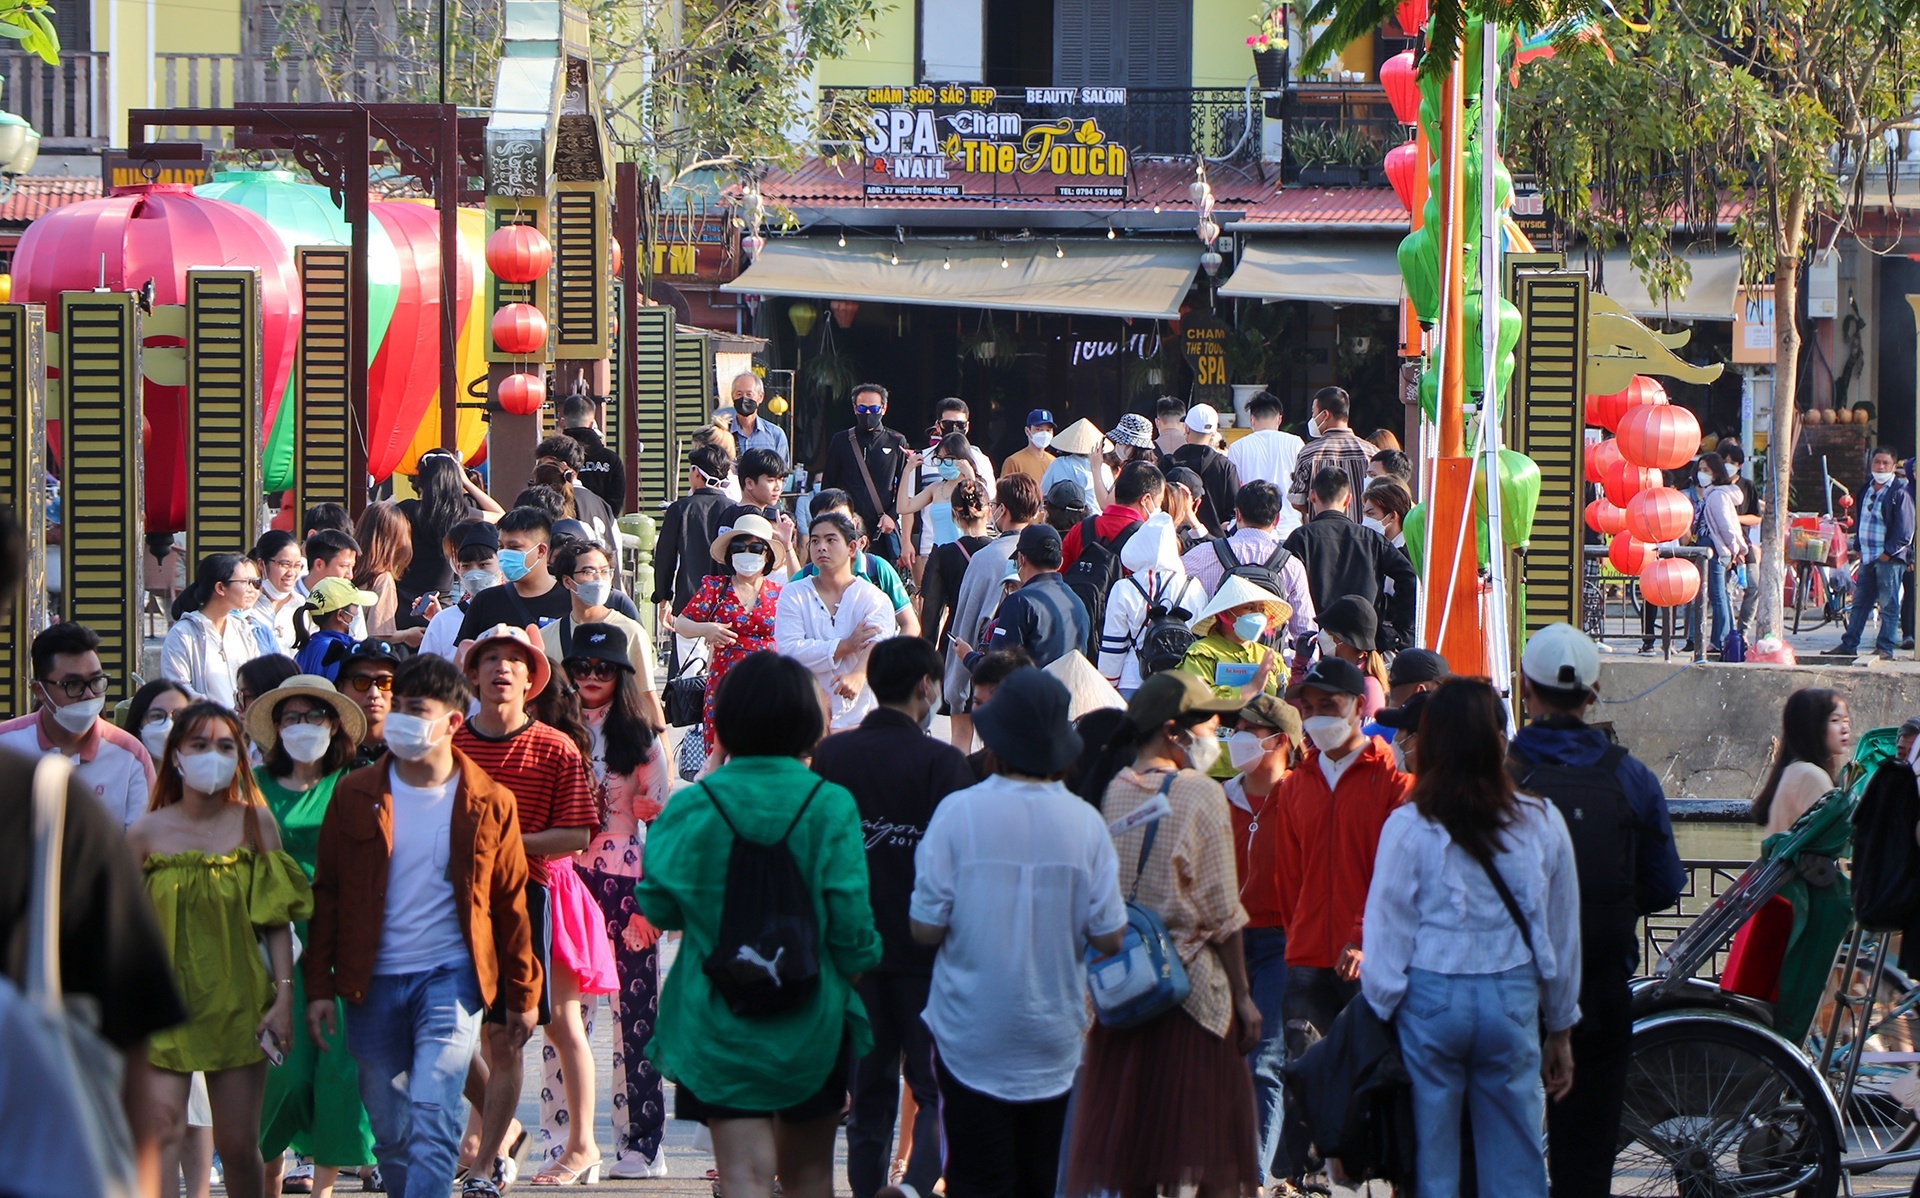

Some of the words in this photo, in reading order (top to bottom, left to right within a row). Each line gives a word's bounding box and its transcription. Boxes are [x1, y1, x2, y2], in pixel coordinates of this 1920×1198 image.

[867, 86, 902, 104] CHĂM
[1026, 90, 1074, 104] BEAUTY
[1082, 90, 1124, 104] SALON
[864, 110, 939, 154] SPA
[962, 141, 1016, 173] The
[1019, 119, 1125, 176] Touch
[873, 158, 885, 172] &
[894, 159, 947, 178] NAIL
[884, 186, 893, 194] 37
[1060, 187, 1074, 196] TEL:
[1094, 187, 1108, 196] 579
[1512, 193, 1544, 216] UÊ
[1186, 342, 1202, 355] THE
[1197, 355, 1227, 385] SPA
[889, 835, 920, 846] 201
